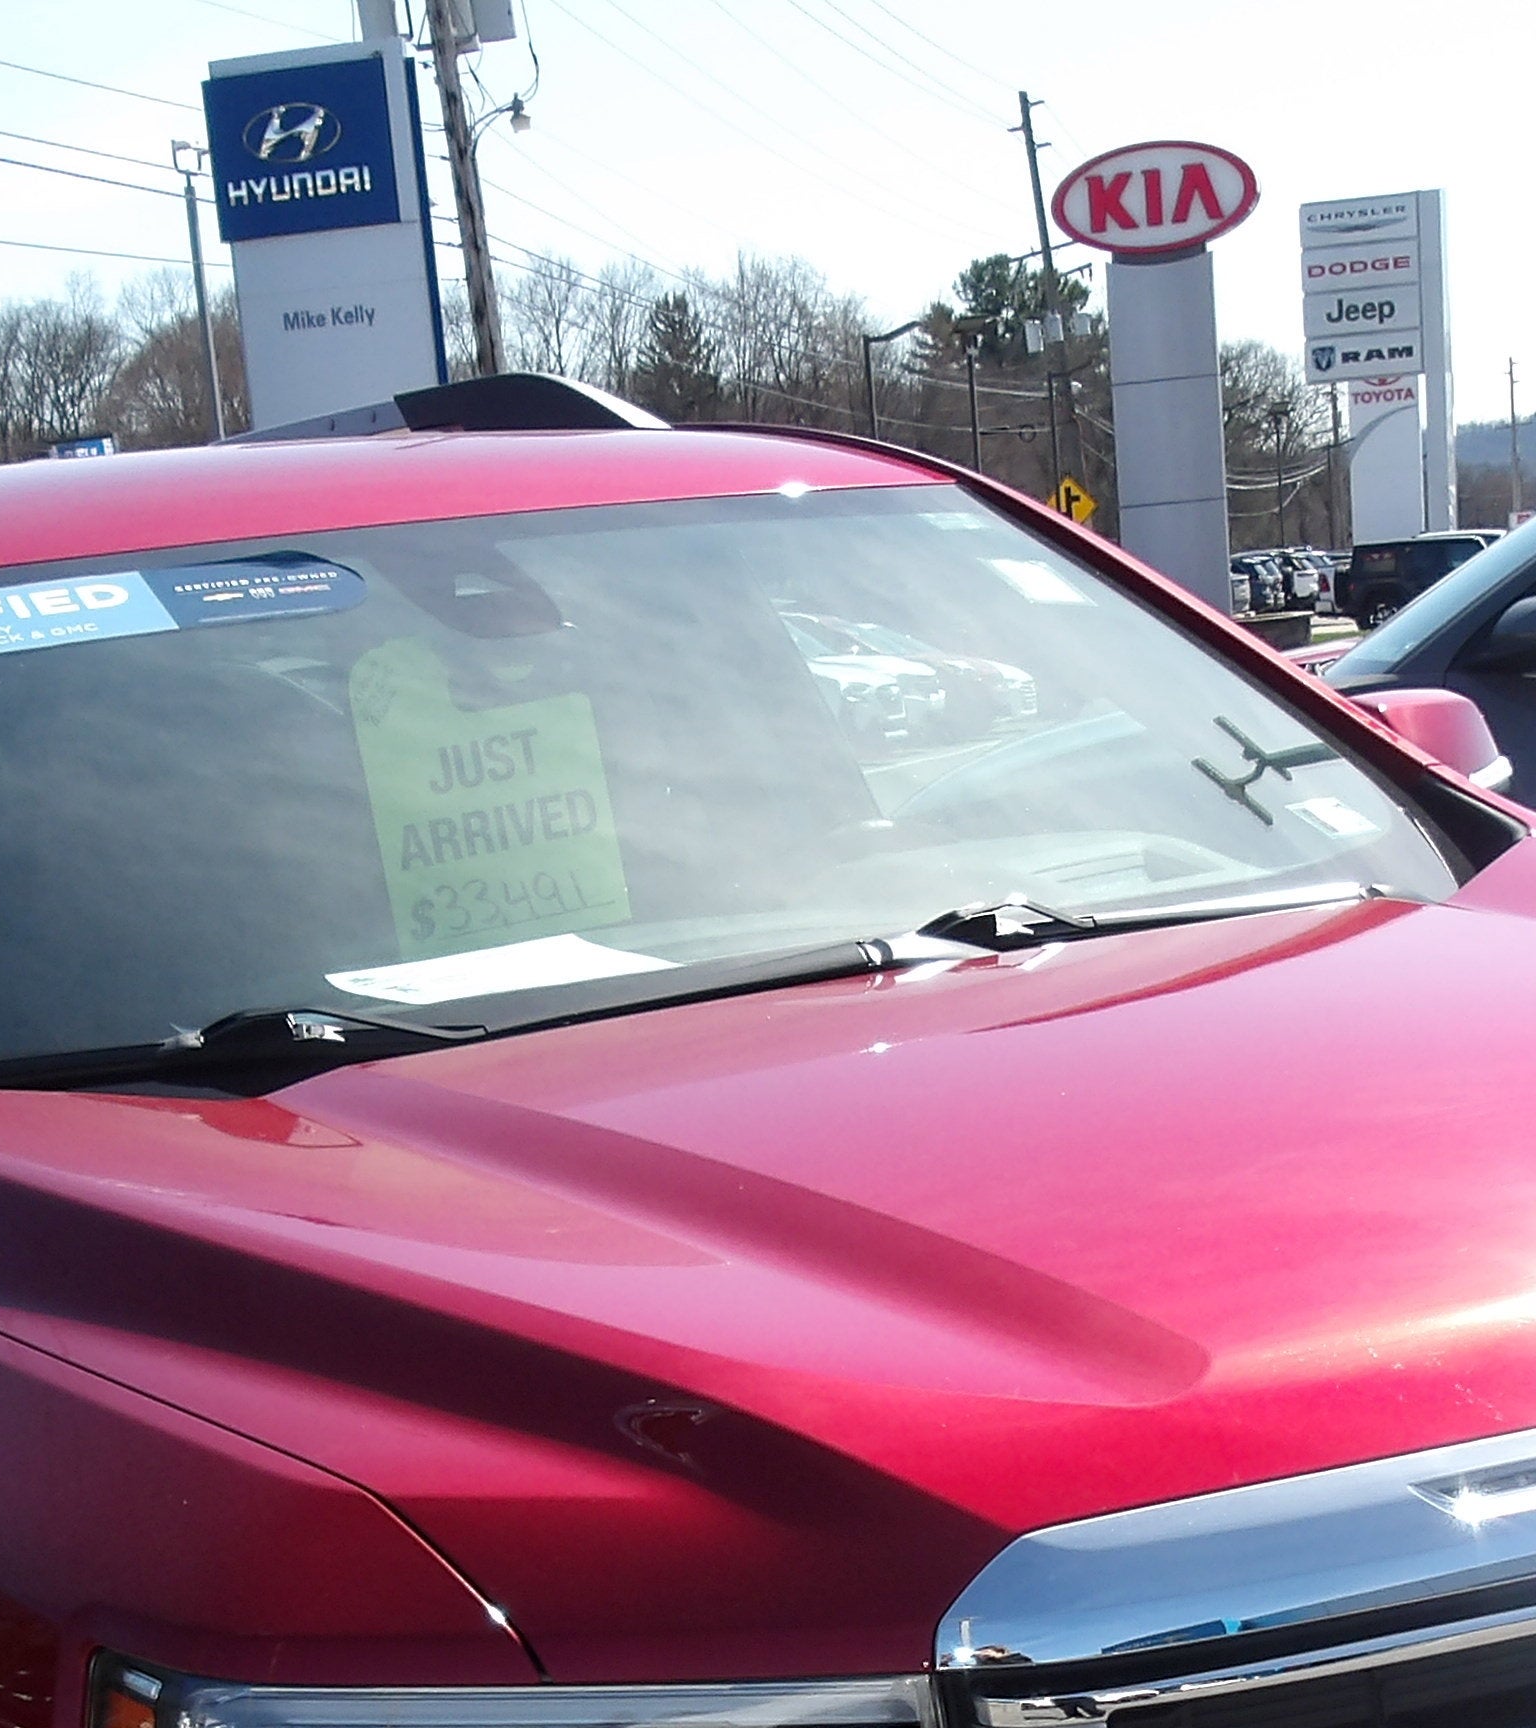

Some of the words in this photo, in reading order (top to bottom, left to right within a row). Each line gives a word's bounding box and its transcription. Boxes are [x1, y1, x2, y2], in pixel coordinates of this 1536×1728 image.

[227, 165, 372, 207] HYUNDAI
[1084, 161, 1225, 234] KIA
[1307, 205, 1407, 223] CHRYSLER
[1307, 255, 1411, 279] DODGE
[282, 308, 326, 331] Mike
[330, 304, 375, 328] Kelly
[1326, 298, 1396, 325] Jeep
[1341, 345, 1414, 365] RAM
[1351, 387, 1415, 405] TOYOTA
[50, 622, 100, 638] GMC
[428, 728, 538, 795] JUST
[399, 788, 598, 871] ARRIVED
